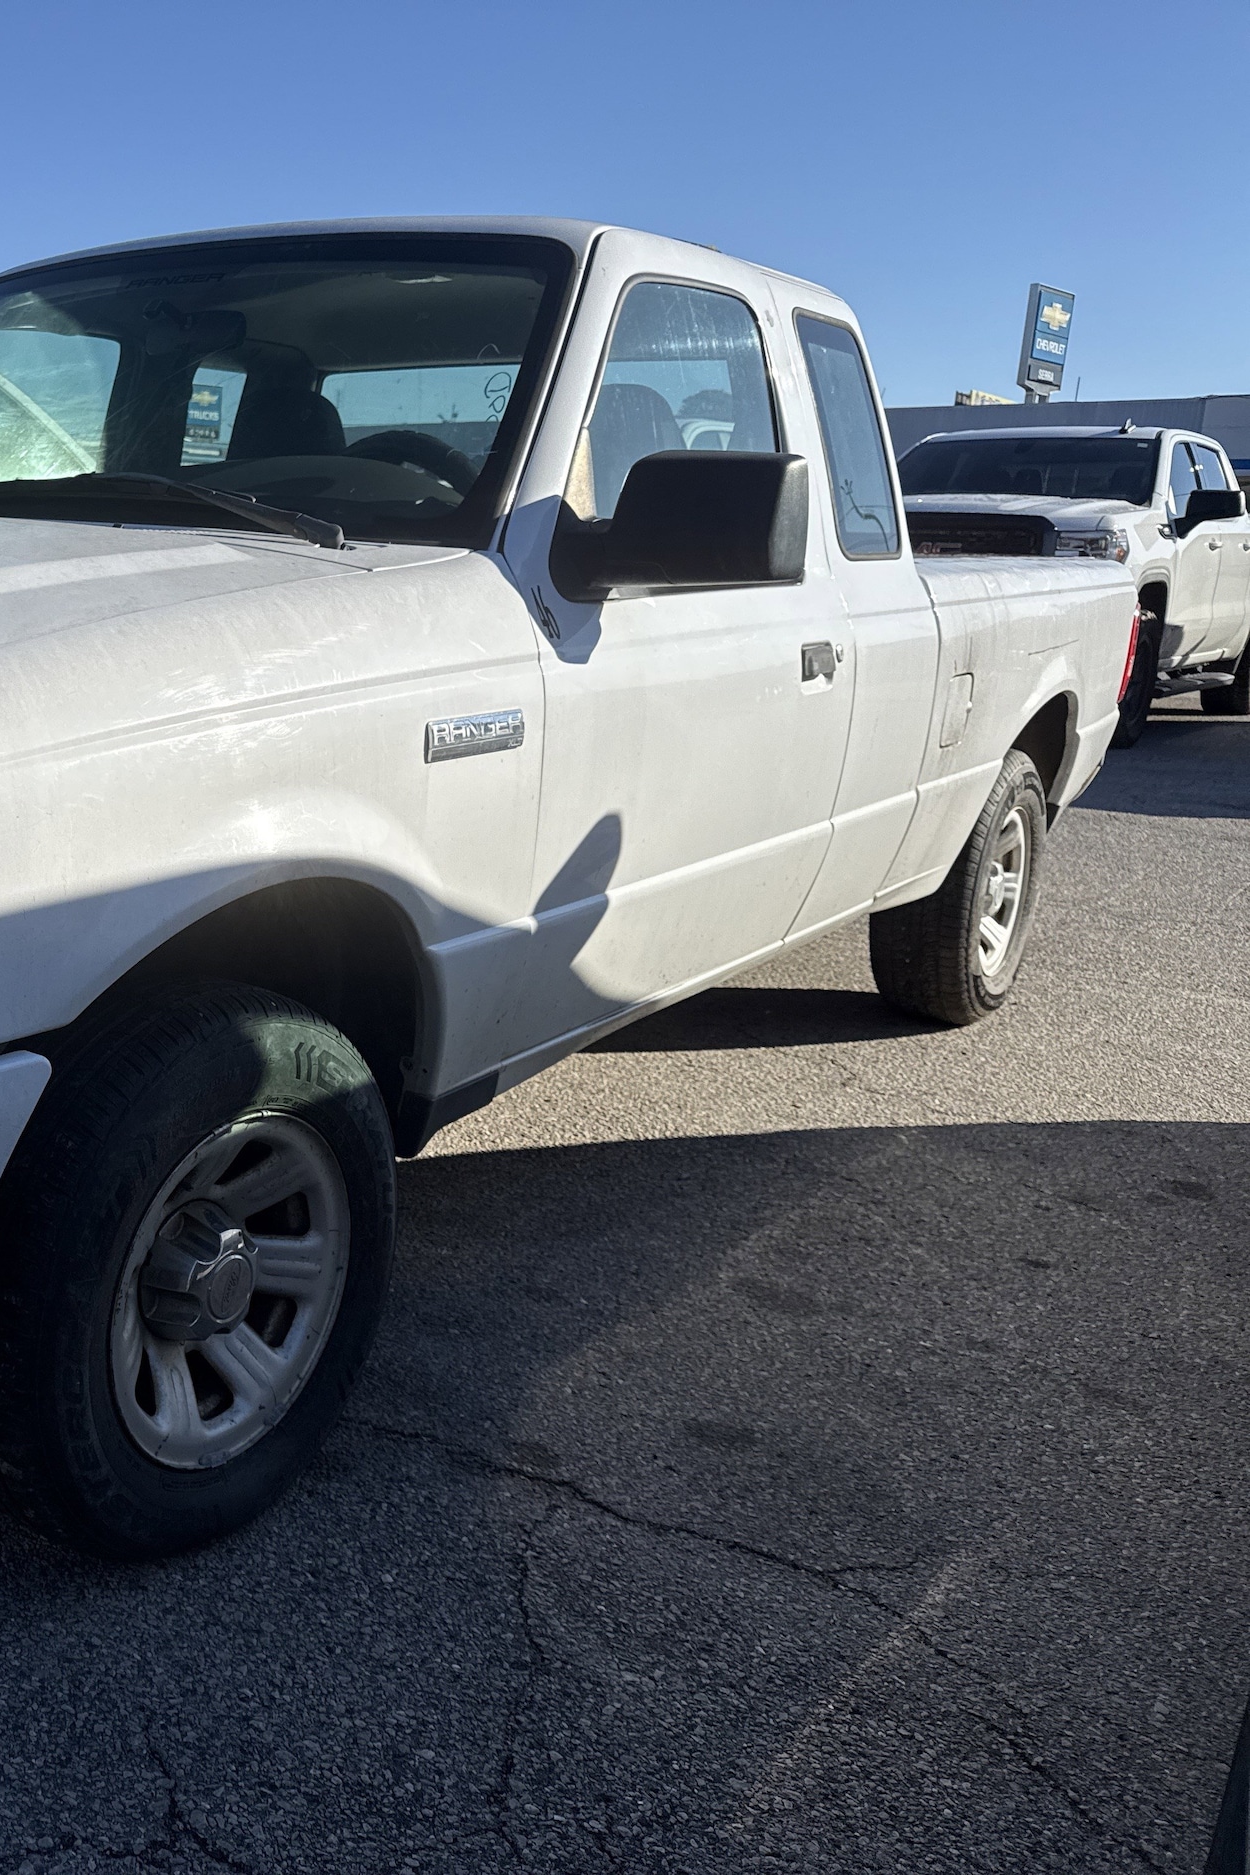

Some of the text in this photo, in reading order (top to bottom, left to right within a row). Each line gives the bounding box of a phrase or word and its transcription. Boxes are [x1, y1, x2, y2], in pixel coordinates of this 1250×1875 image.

[125, 272, 226, 289] RANGER
[1035, 338, 1066, 355] CHEVROLET
[188, 410, 219, 421] TRUCKS
[432, 713, 523, 746] RANGER
